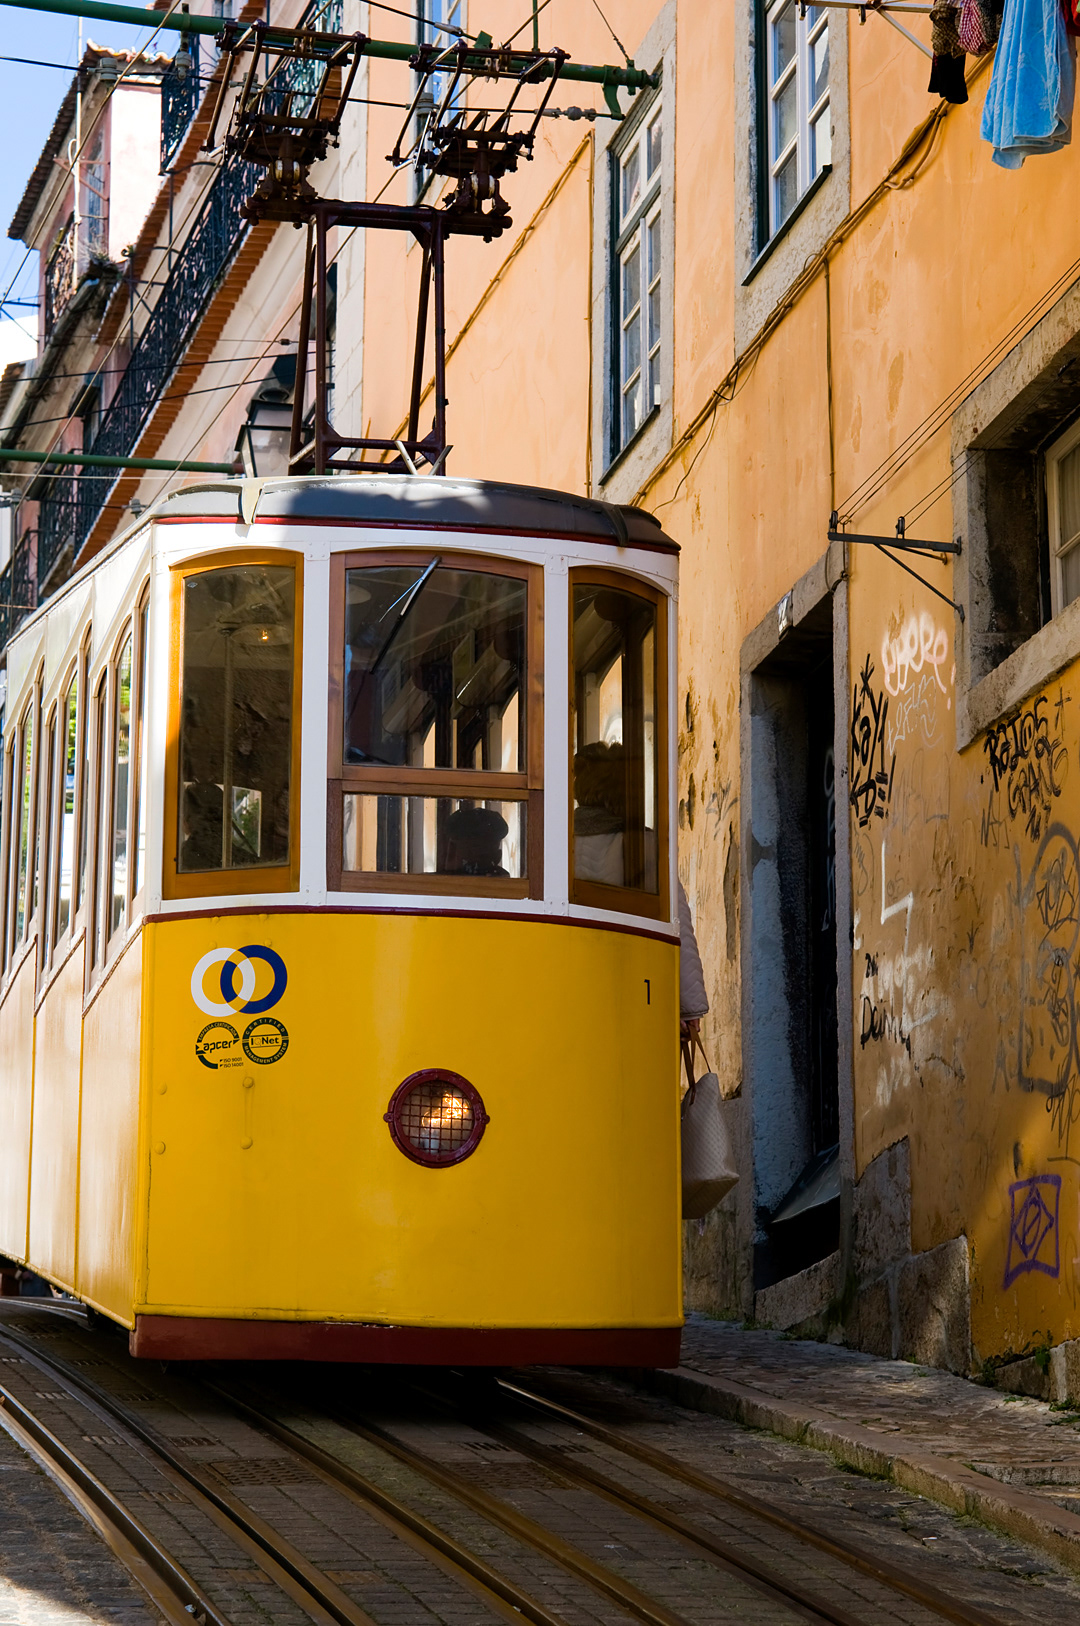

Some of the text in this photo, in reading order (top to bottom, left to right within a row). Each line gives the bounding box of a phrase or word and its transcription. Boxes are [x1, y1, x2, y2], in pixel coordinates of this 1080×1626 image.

[643, 978, 651, 1006] 1
[245, 1018, 287, 1036] CERTIFIED
[203, 1040, 232, 1053] apcer
[244, 1042, 288, 1064] MANAGEMENT SYSTEM
